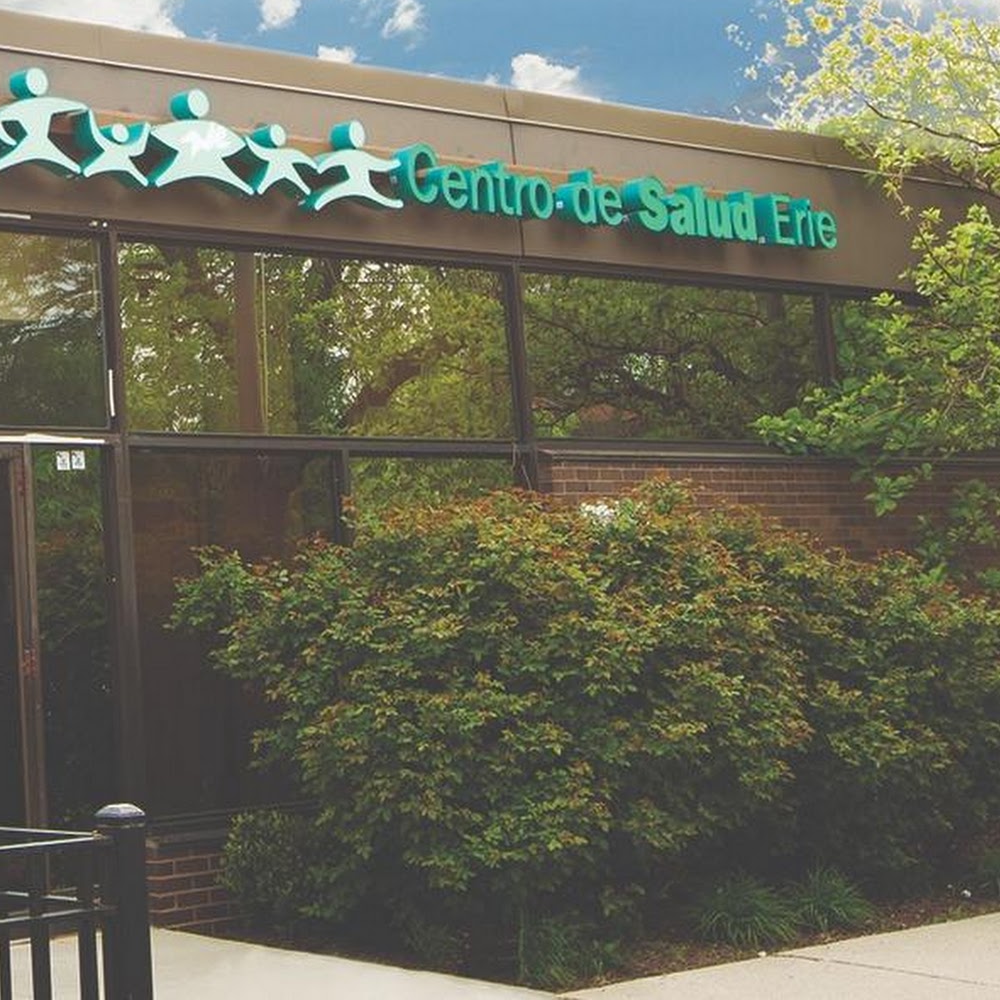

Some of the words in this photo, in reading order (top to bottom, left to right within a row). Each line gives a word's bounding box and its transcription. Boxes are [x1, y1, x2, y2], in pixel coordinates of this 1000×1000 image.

[396, 142, 554, 221] Centro
[556, 168, 624, 226] de
[621, 175, 757, 244] Salud
[754, 191, 839, 250] Erie
